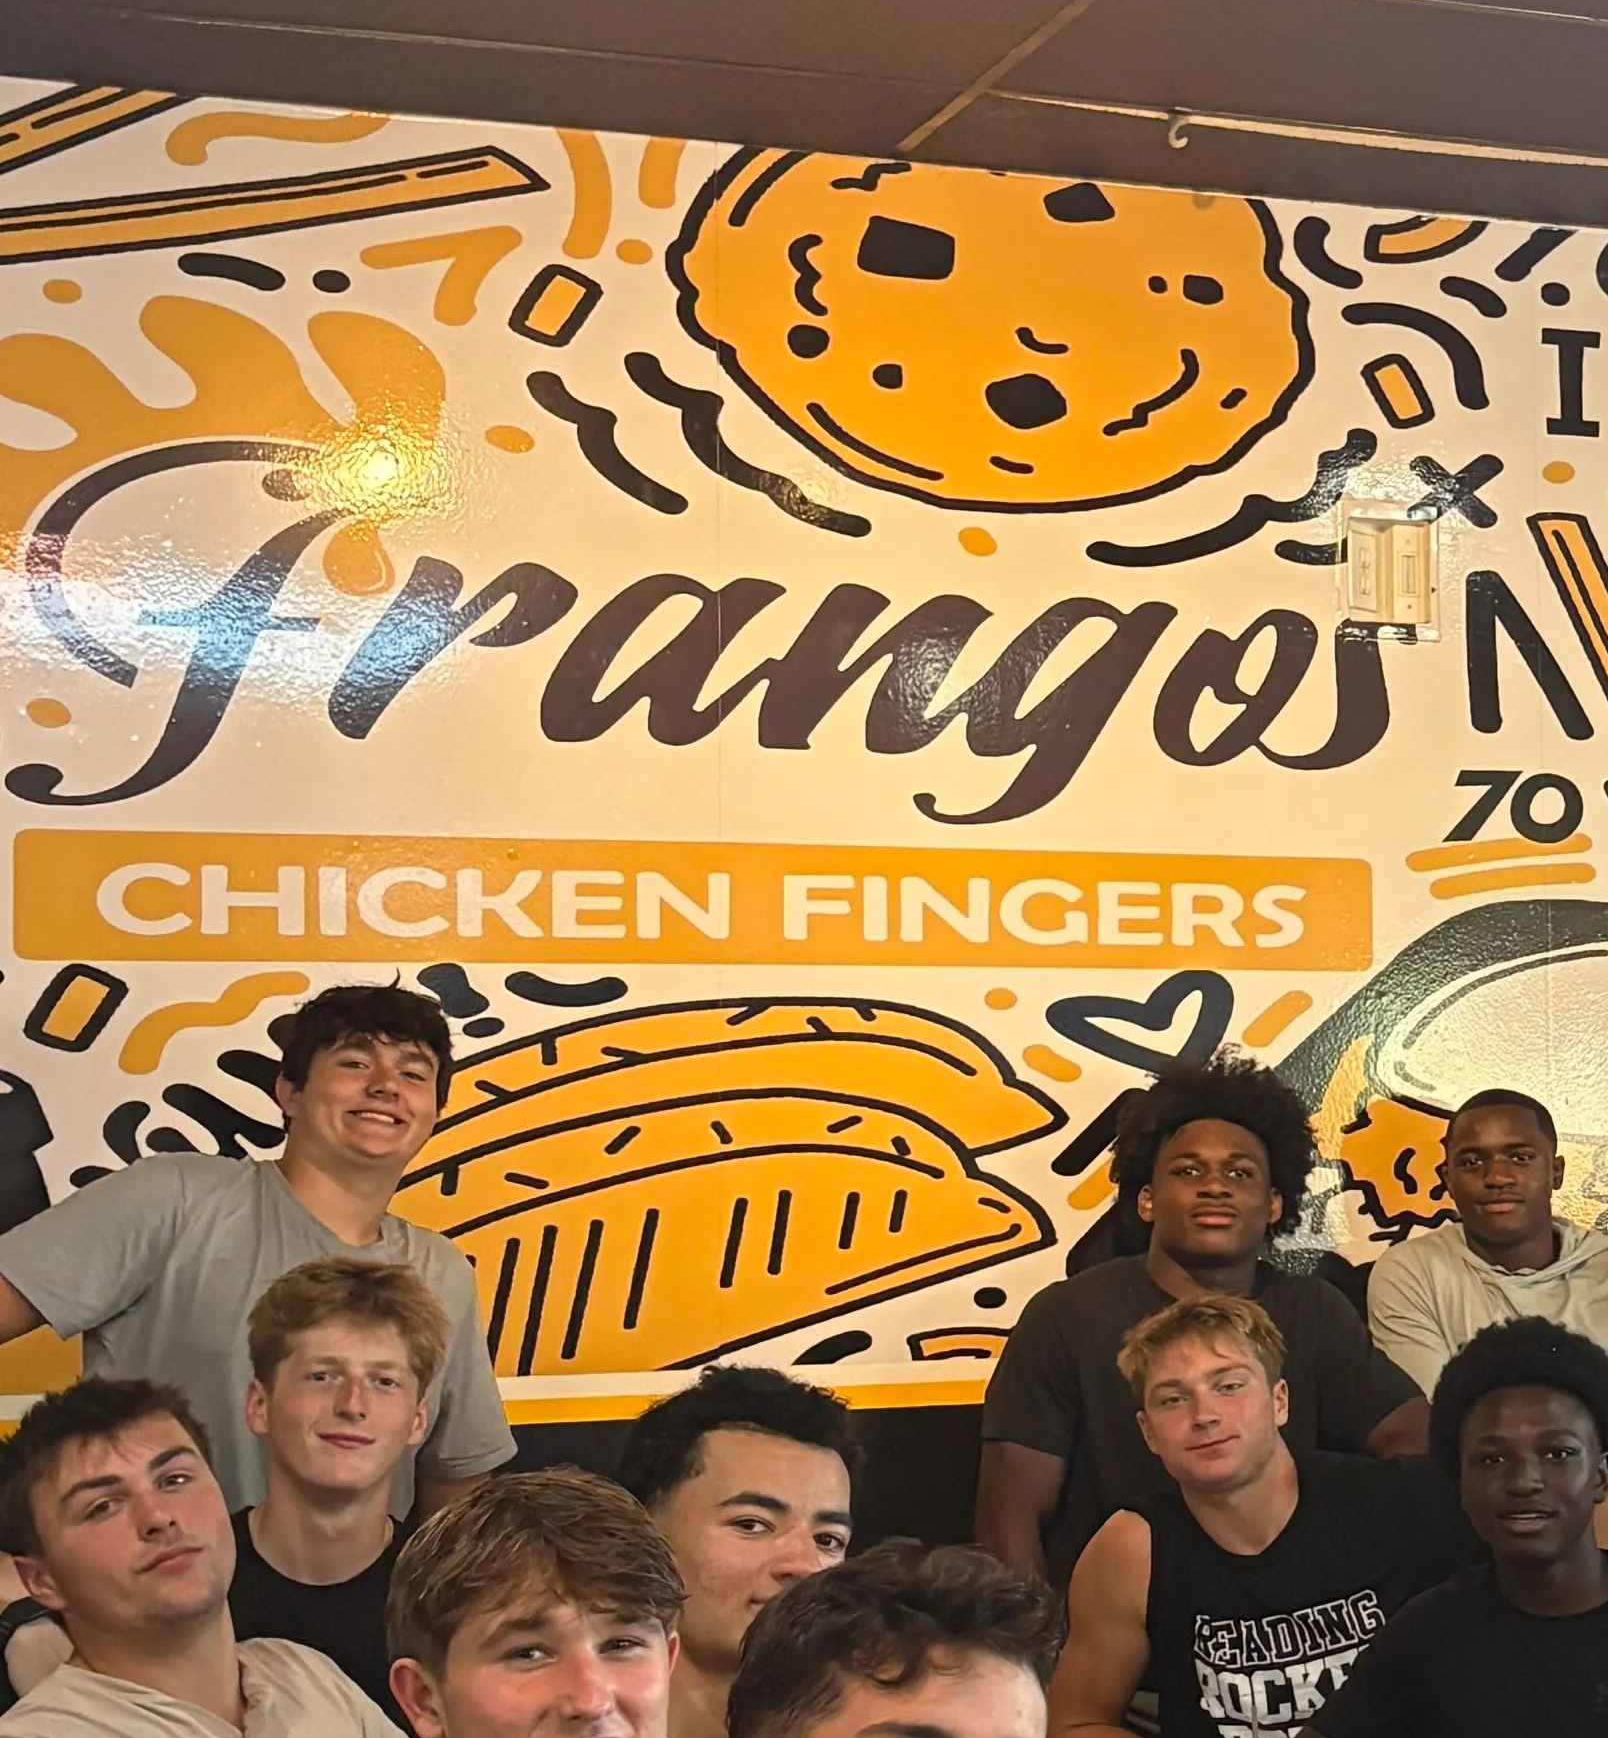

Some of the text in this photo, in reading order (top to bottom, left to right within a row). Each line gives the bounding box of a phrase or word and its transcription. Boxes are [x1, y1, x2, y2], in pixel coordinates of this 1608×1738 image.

[1541, 329, 1601, 437] I
[96, 862, 1308, 949] CHICKEN FINGERS
[1194, 1589, 1386, 1668] READING
[1195, 1643, 1370, 1725] ROCKE
